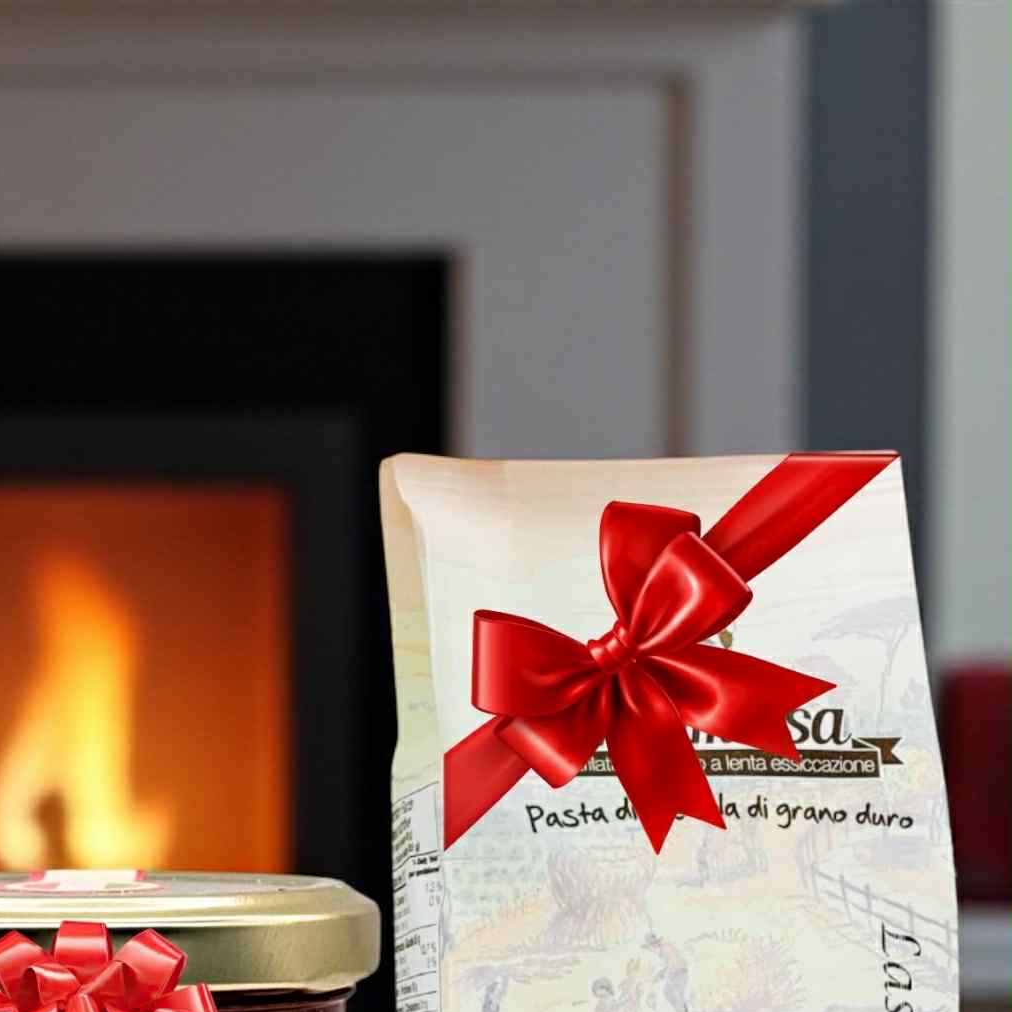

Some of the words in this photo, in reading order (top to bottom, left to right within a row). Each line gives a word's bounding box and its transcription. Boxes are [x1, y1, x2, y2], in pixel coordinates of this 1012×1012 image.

[711, 759, 722, 770] a
[726, 755, 767, 770] lenta
[770, 756, 875, 772] essiccazione
[526, 802, 608, 832] Pasta
[747, 796, 768, 819] di
[776, 802, 847, 829] grano
[856, 803, 914, 829] duro
